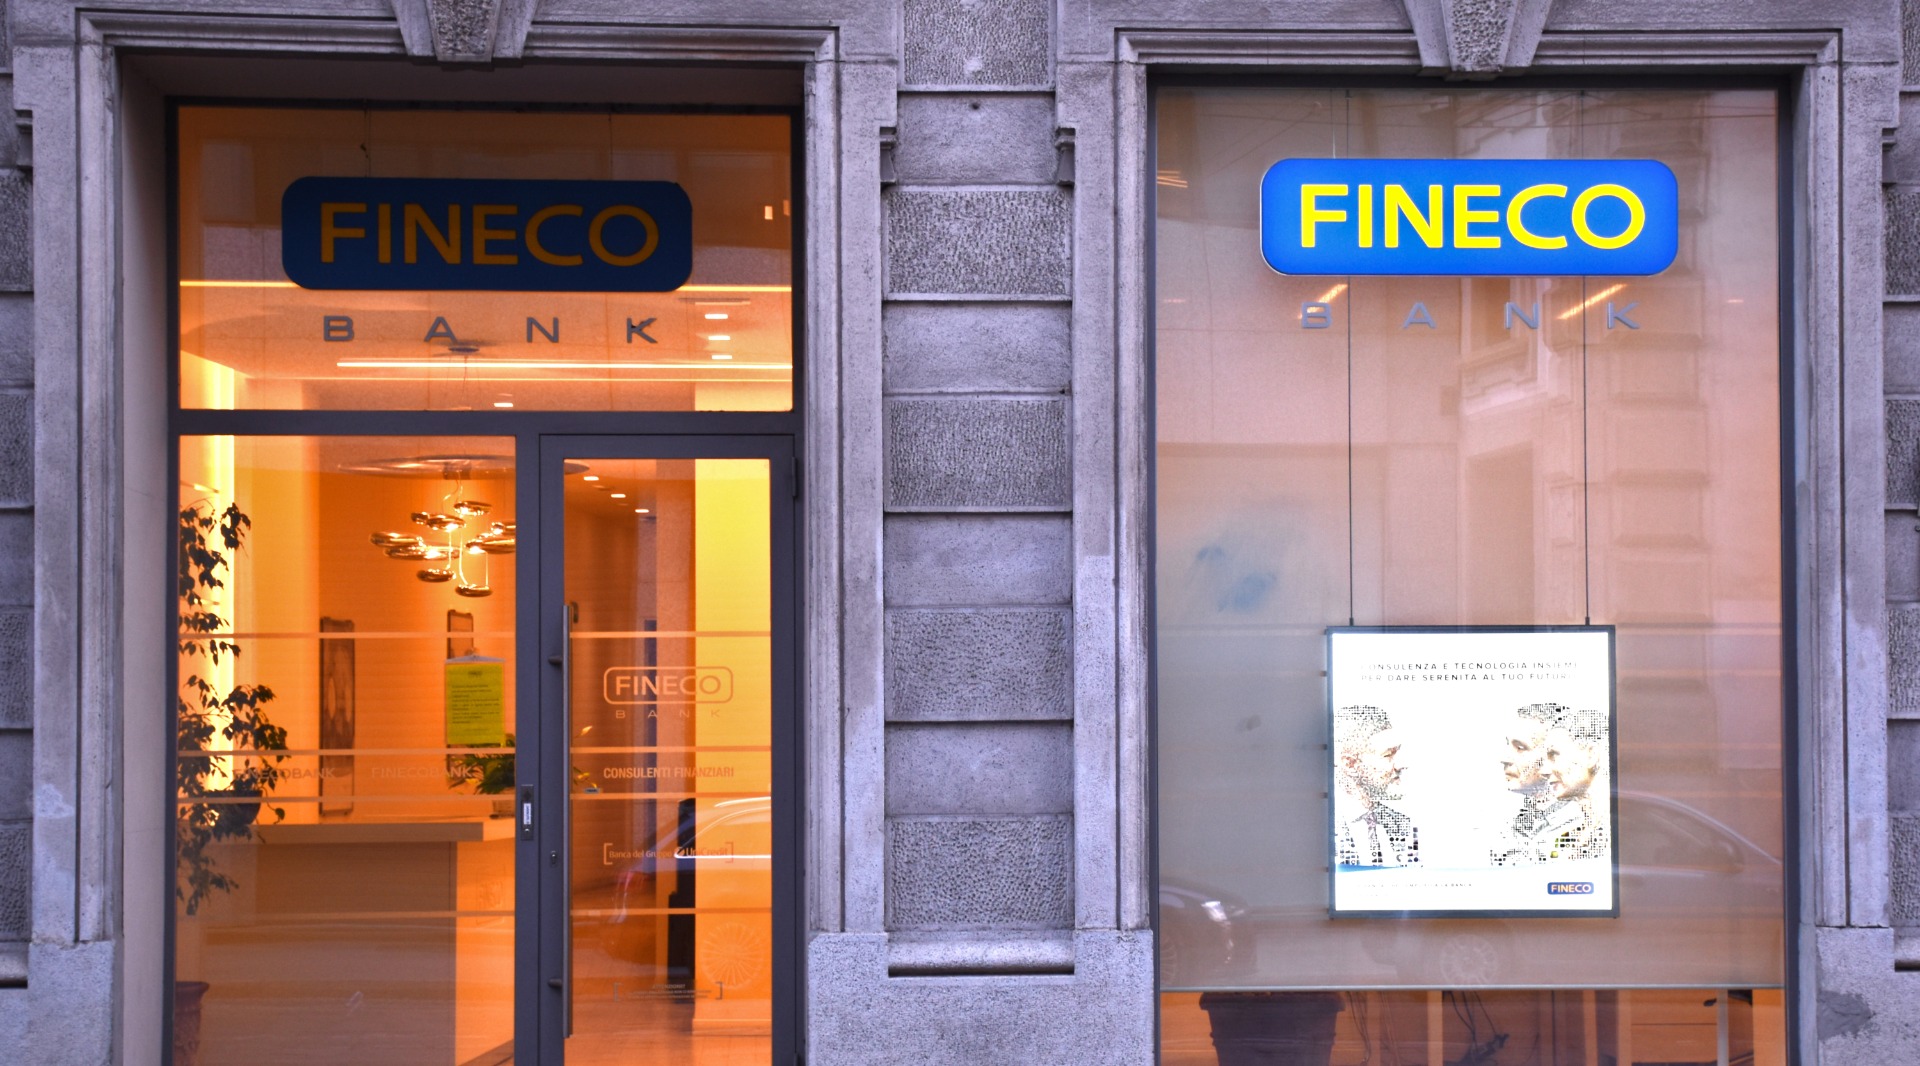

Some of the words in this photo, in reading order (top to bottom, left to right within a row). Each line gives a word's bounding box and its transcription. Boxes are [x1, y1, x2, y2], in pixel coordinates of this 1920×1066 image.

[1300, 183, 1646, 250] FINECO
[320, 202, 660, 267] FINECO
[1300, 301, 1641, 329] BANK
[323, 315, 659, 344] BANK
[1454, 662, 1527, 670] TECNOLOGIA
[1387, 674, 1416, 682] DARE
[1483, 673, 1495, 681] AL
[1502, 673, 1524, 681] TUO
[615, 675, 721, 696] FINECO
[615, 709, 721, 719] BANK
[603, 767, 671, 779] CONSULENTI
[674, 767, 734, 779] FINANZIARI
[609, 850, 631, 858] Banca
[633, 849, 644, 858] del
[1551, 884, 1592, 893] FINECO
